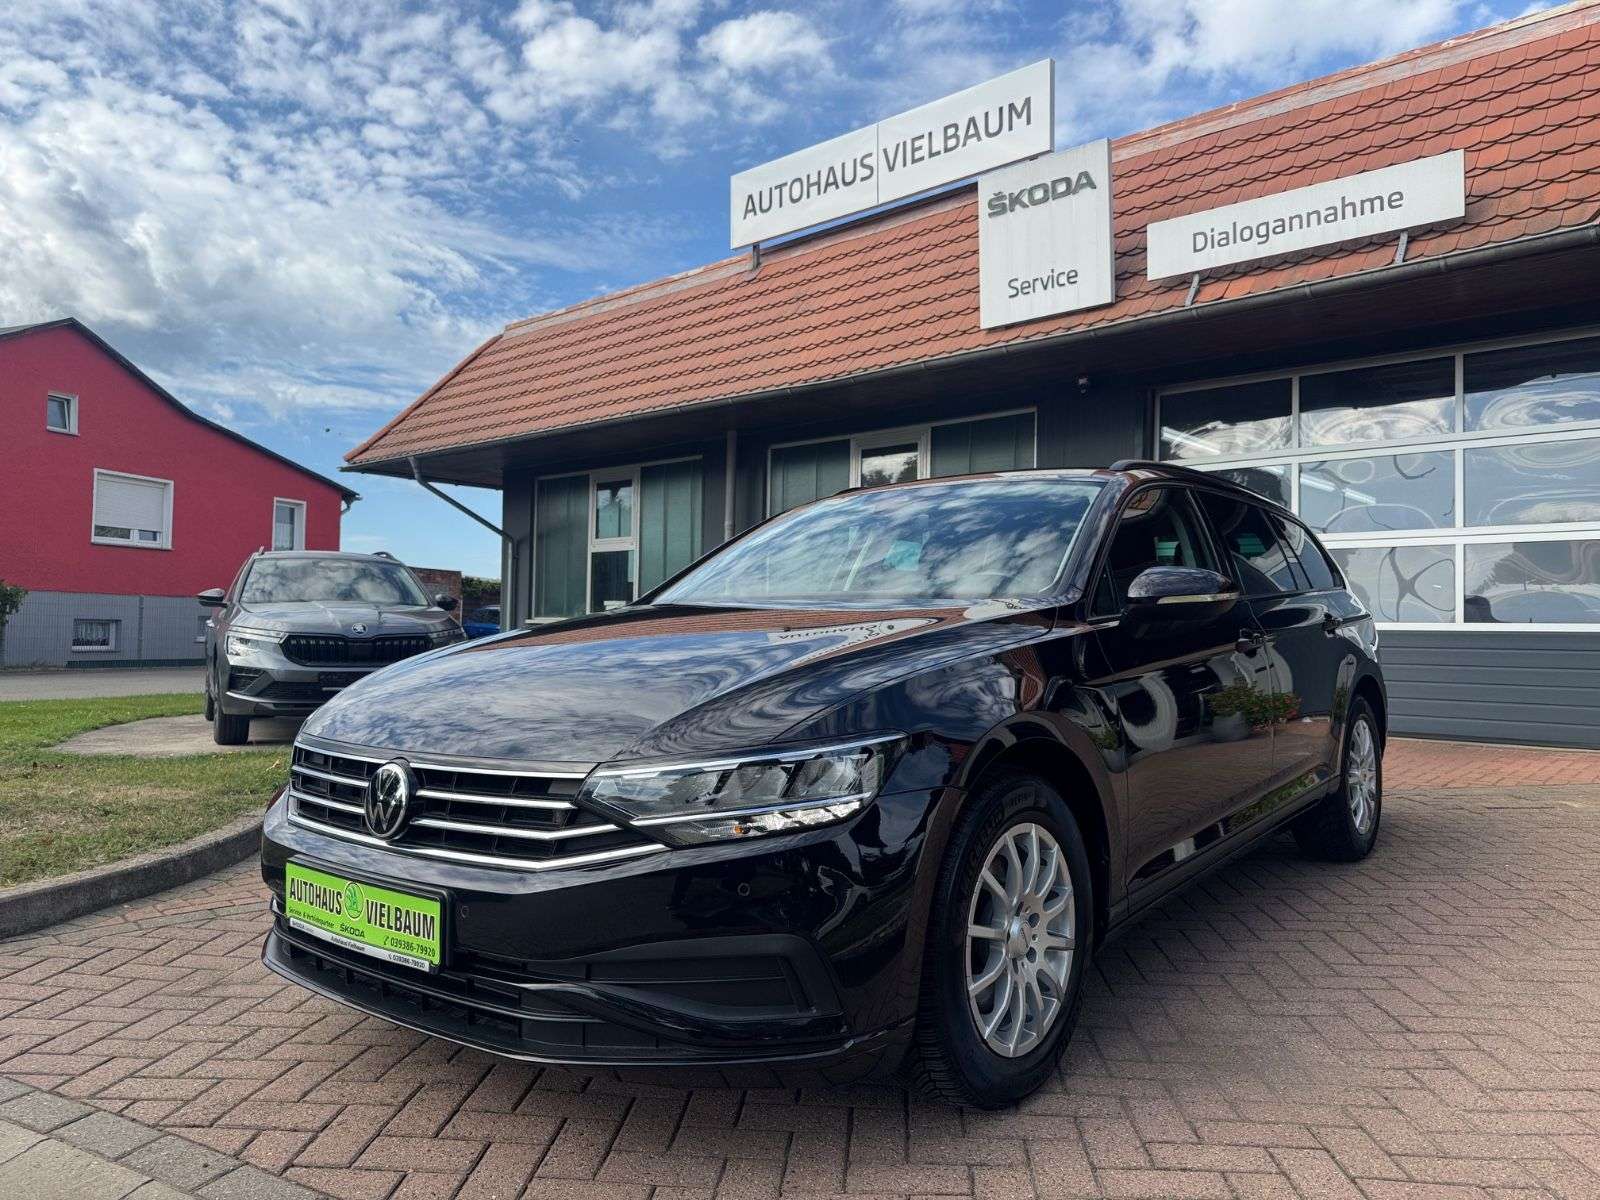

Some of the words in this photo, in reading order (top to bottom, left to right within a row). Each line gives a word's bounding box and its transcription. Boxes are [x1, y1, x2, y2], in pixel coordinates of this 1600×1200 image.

[743, 152, 874, 220] AUTOHAUS
[882, 96, 1032, 173] VIELBAUM
[987, 170, 1097, 218] ŠKODA
[1192, 190, 1404, 253] Dialogannahme
[1007, 268, 1079, 299] Service
[289, 877, 342, 915] AUTOHAUS
[366, 899, 435, 941] VIELBAUM
[390, 937, 436, 957] 039386-79920
